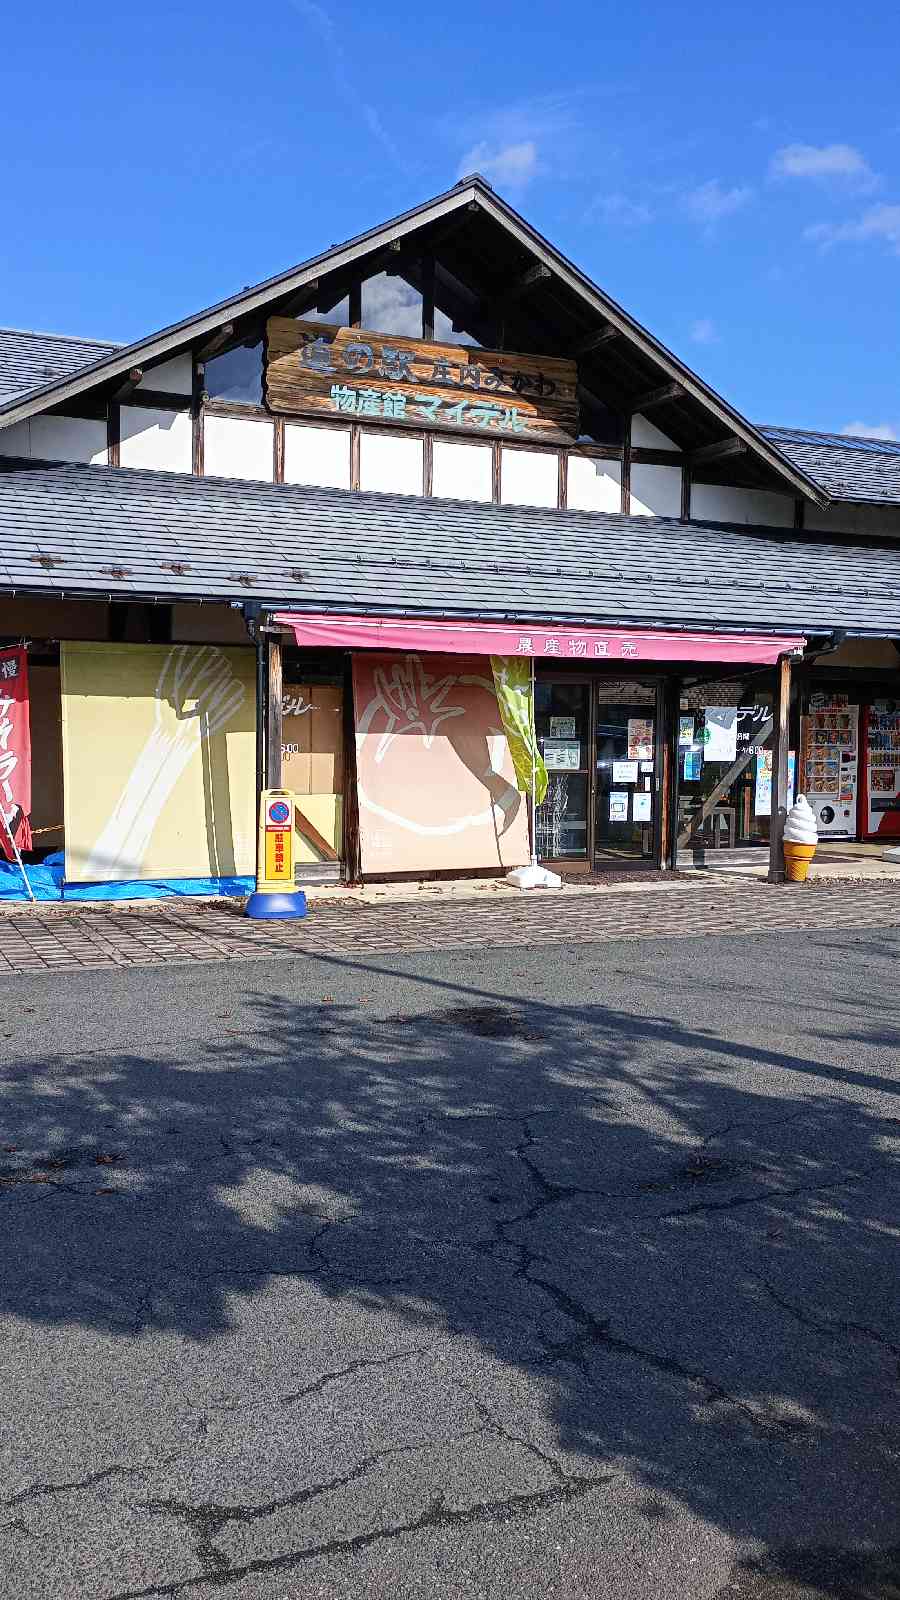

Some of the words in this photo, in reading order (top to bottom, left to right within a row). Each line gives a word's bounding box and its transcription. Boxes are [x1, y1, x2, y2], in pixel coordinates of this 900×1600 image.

[330, 384, 407, 418] 物産館
[414, 394, 529, 433] マイデル
